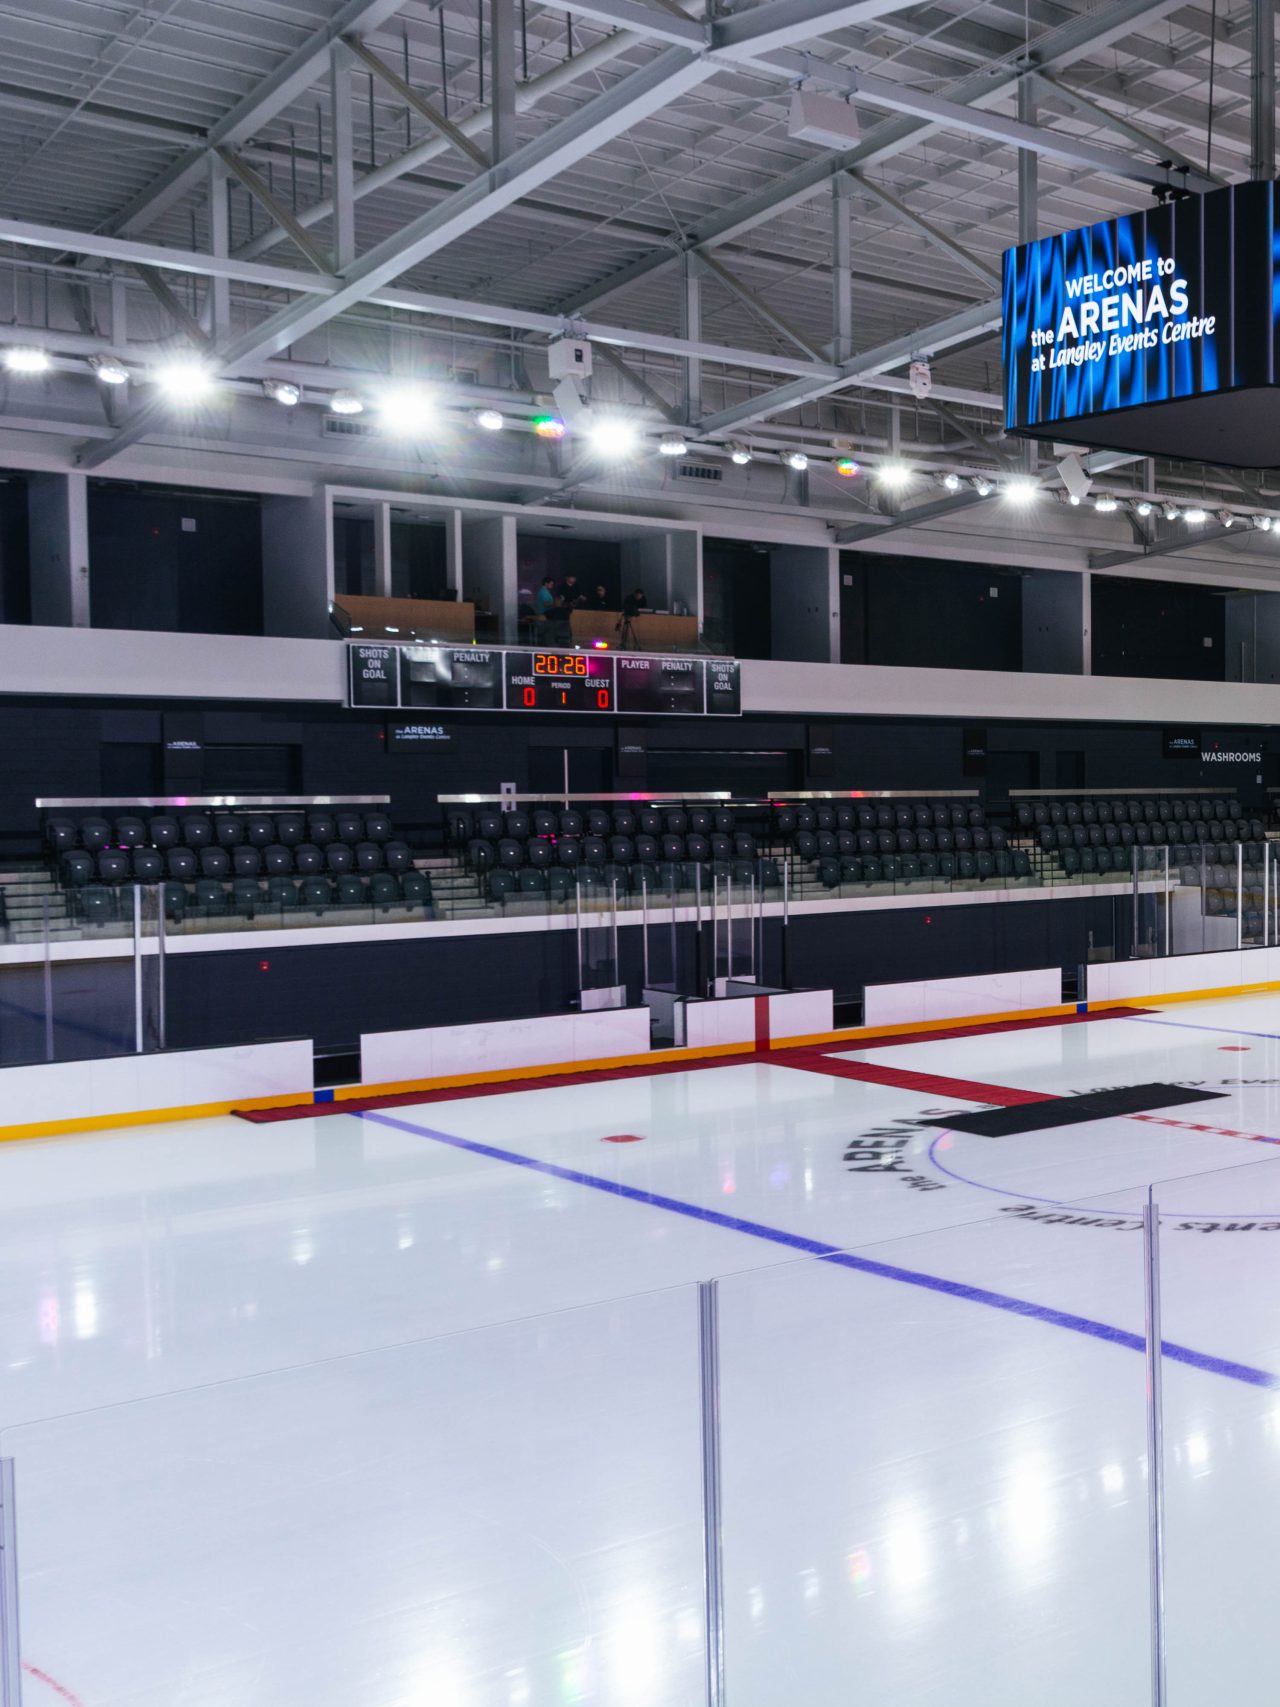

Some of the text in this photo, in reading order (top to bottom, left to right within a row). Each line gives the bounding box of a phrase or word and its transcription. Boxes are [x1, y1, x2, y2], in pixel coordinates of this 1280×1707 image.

[1065, 257, 1176, 299] WELCOME to
[1031, 279, 1189, 347] the ARENAS
[1031, 315, 1216, 372] at Langley Events Centre
[359, 649, 389, 658] SHOTS
[453, 653, 490, 662] PENALTY
[367, 659, 381, 668] ON
[535, 655, 586, 675] 20:26
[621, 660, 650, 669] PLAYER
[662, 662, 693, 671] PENALTY
[711, 664, 735, 672] SHOTS
[362, 669, 387, 679] GOAL
[717, 673, 729, 681] ON
[511, 676, 536, 685] HOME
[584, 679, 610, 687] GUEST
[713, 682, 733, 690] GOAL
[523, 687, 536, 706] 0
[562, 691, 567, 704] 1
[597, 689, 609, 708] 0
[404, 726, 444, 734] ARENAS
[1201, 752, 1261, 762] WASHROOMS
